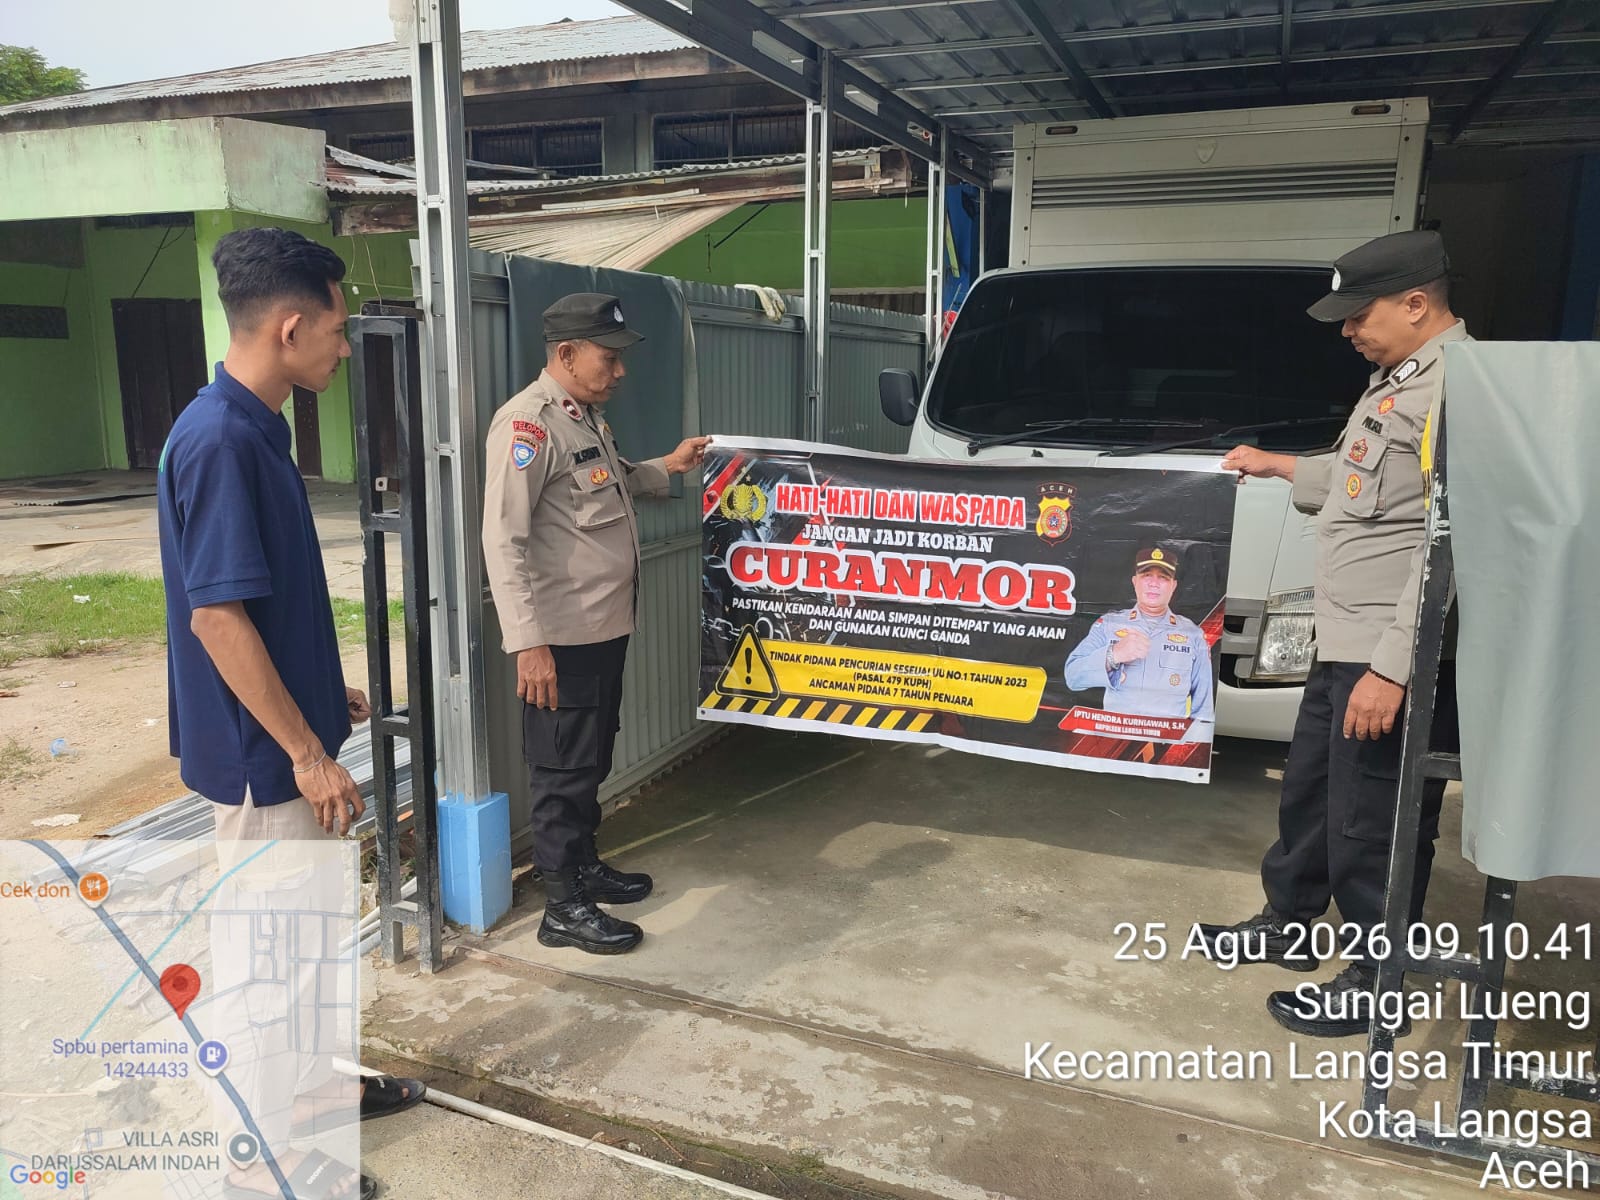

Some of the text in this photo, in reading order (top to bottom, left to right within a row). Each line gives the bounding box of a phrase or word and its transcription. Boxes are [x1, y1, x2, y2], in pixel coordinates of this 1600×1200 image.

[1040, 485, 1073, 494] ACEH
[776, 484, 1026, 529] HATI-HATI DAN WASPADA
[802, 524, 993, 552] JANGAN JADI KORBAN
[728, 543, 1073, 613] CURANMOR
[732, 598, 1066, 640] PASTIKAN KENDARAAN ANDA SIMPAN DITEMPAT YANG AMAN
[809, 618, 970, 645] DAN GUNAKAN KUNCI GANDA
[1163, 644, 1190, 653] POLRI
[770, 651, 802, 663] TINDAK
[803, 654, 837, 667] PIDANA
[838, 658, 892, 672] PENCURIAN
[946, 670, 967, 680] NO.1
[970, 673, 1002, 685] TAHUN
[1005, 677, 1027, 687] 2023
[853, 672, 932, 690] (PASAL 479 KUPH)
[809, 678, 973, 707] ANCAMAN PIDANA 7 TAHUN PENJARA
[1074, 710, 1187, 730] IPTU HENDRA KURNIAWAN, S.H.
